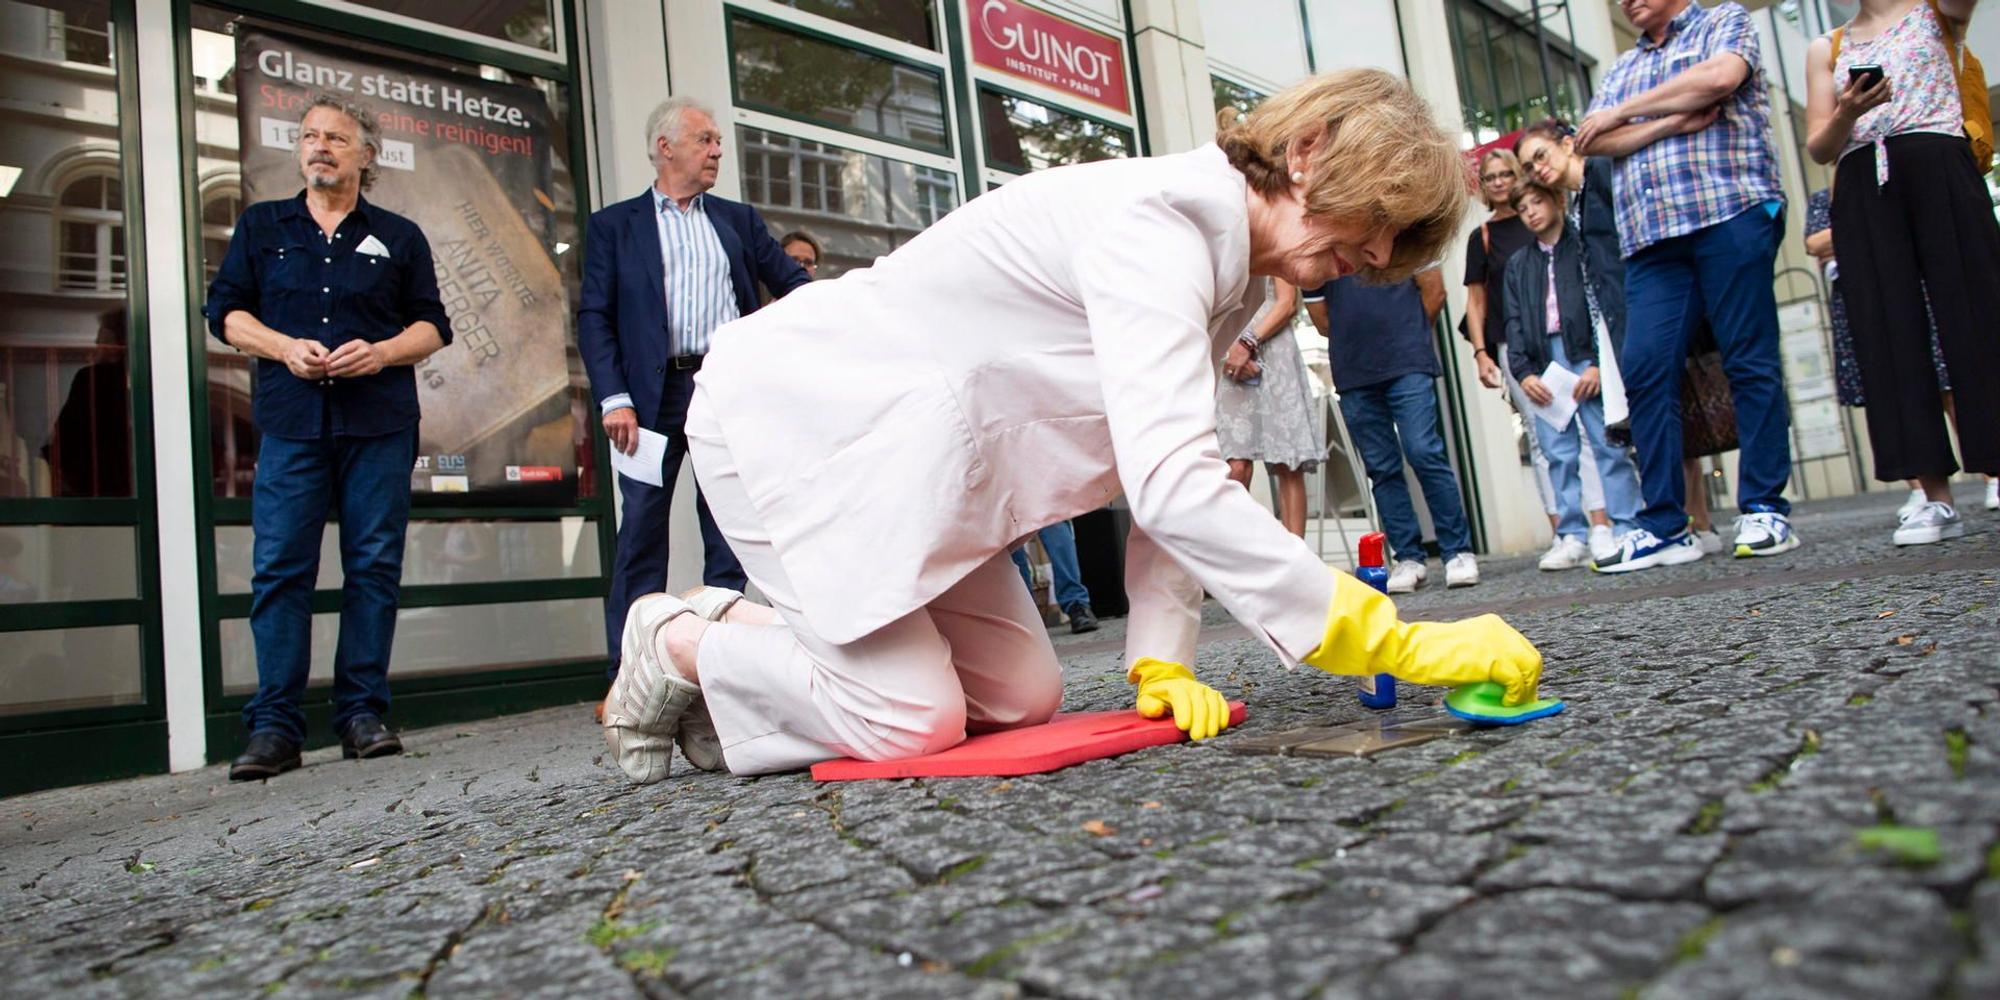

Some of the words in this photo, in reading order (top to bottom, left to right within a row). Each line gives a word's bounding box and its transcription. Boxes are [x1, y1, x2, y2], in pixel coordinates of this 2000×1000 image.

[980, 0, 1112, 86] GUINOT
[1005, 57, 1058, 83] INSTITUT
[1069, 78, 1101, 97] PARIS
[258, 50, 353, 92] Glanz
[360, 72, 434, 108] statt
[441, 86, 531, 128] Hetze.
[435, 122, 533, 156] reinigen!
[440, 239, 503, 309] ANITA
[456, 201, 490, 240] HIER
[485, 240, 536, 307] WOHNTE
